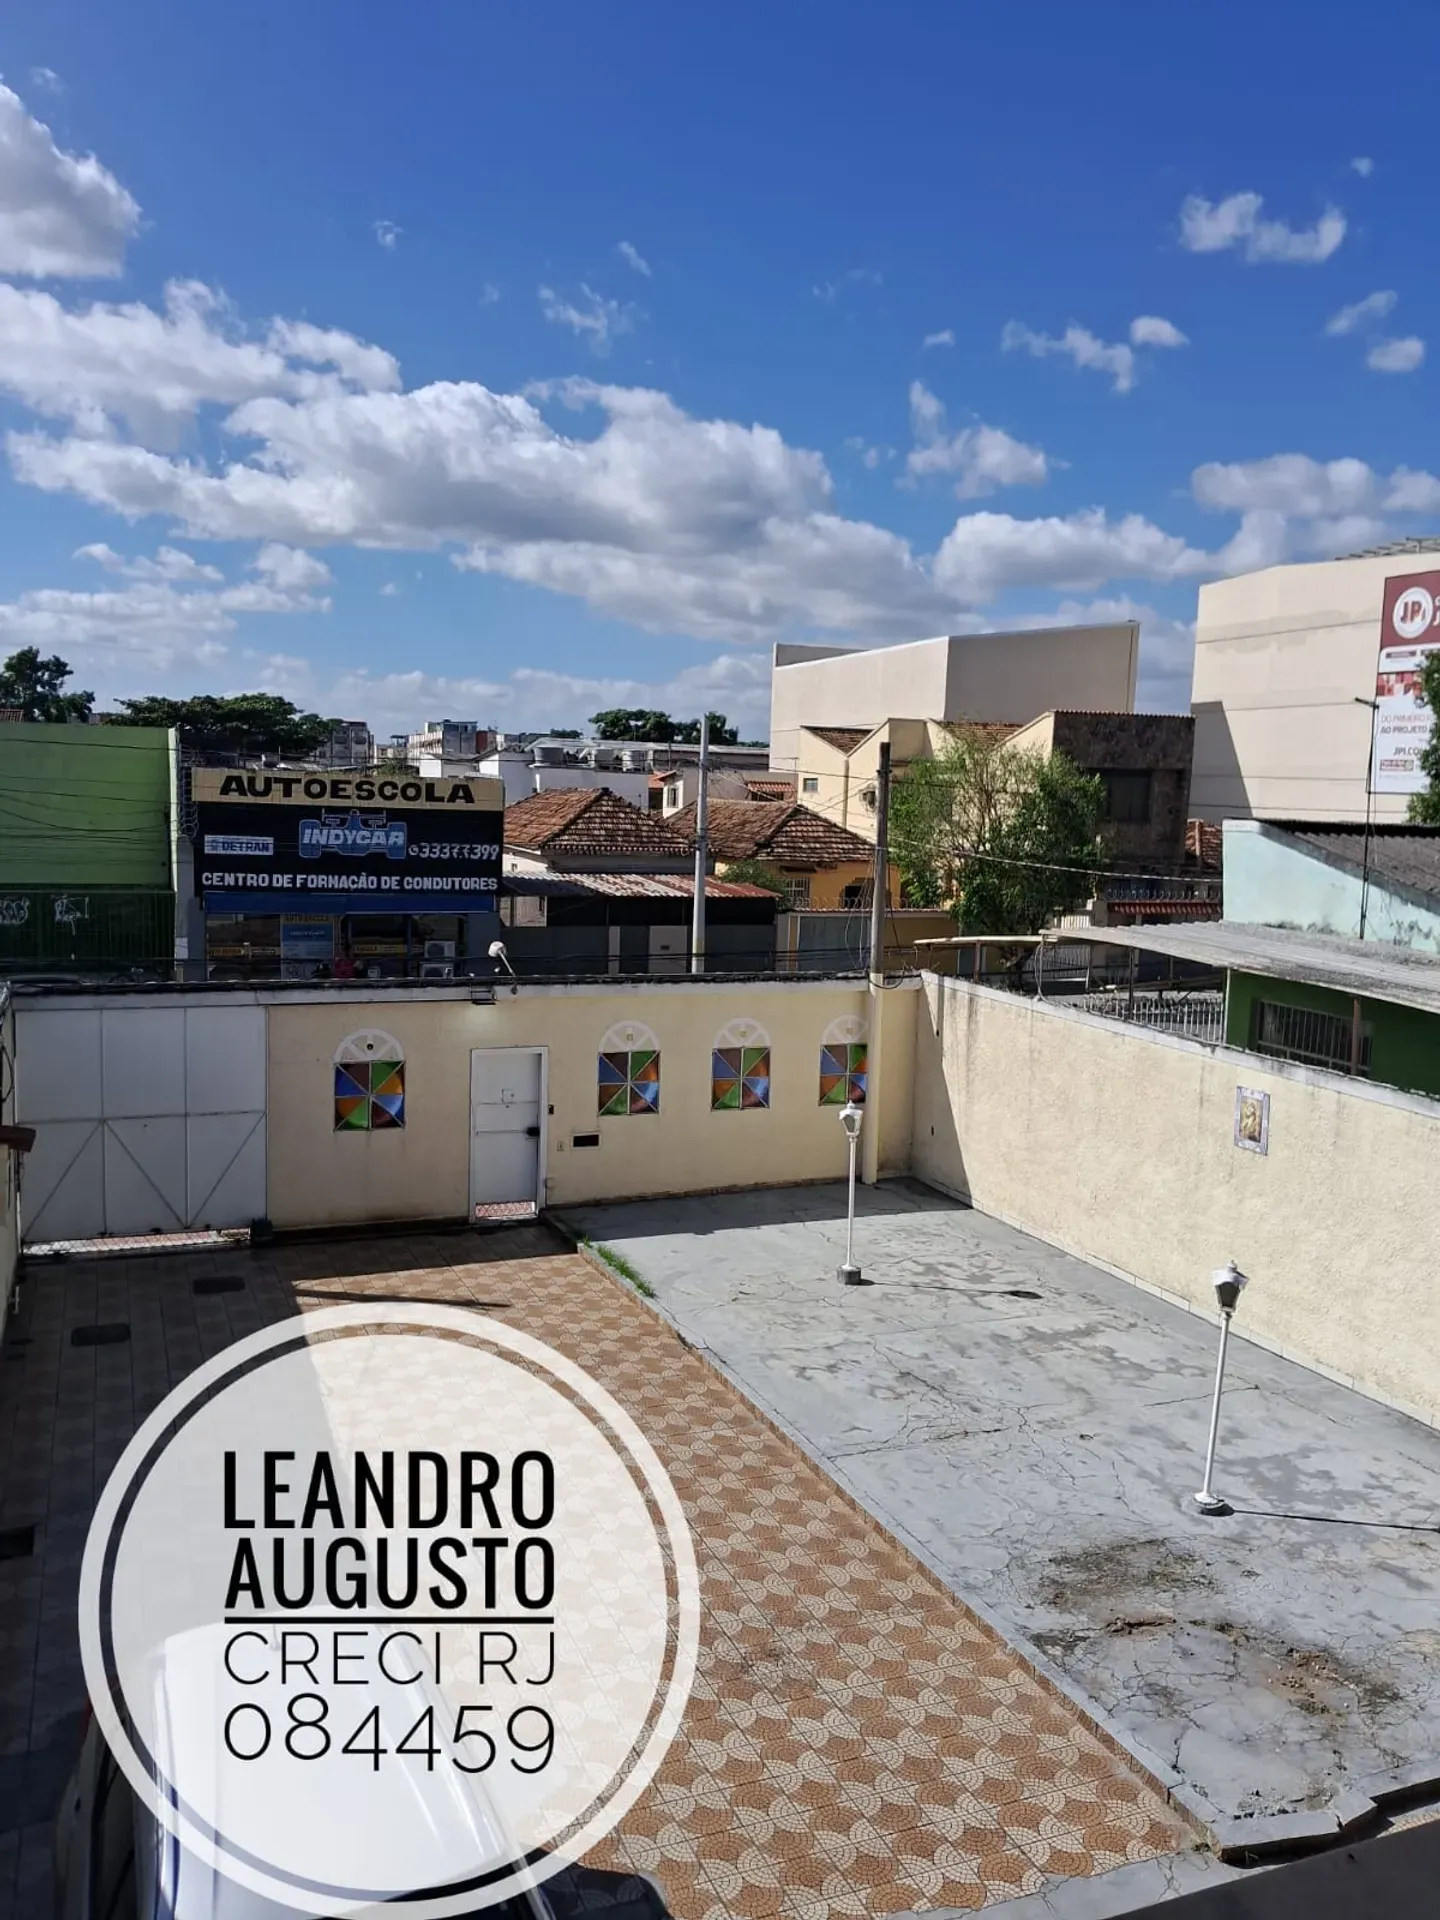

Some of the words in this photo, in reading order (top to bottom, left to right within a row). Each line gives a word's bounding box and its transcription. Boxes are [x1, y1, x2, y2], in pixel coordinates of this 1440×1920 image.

[219, 775, 475, 804] AUTOESCOLA
[302, 828, 405, 846] INDYCAR
[201, 872, 269, 887] CENTRO
[272, 873, 293, 888] DE
[296, 872, 377, 891] FORMAÇÃO
[380, 876, 400, 889] DE
[403, 877, 498, 891] CONDUTORES
